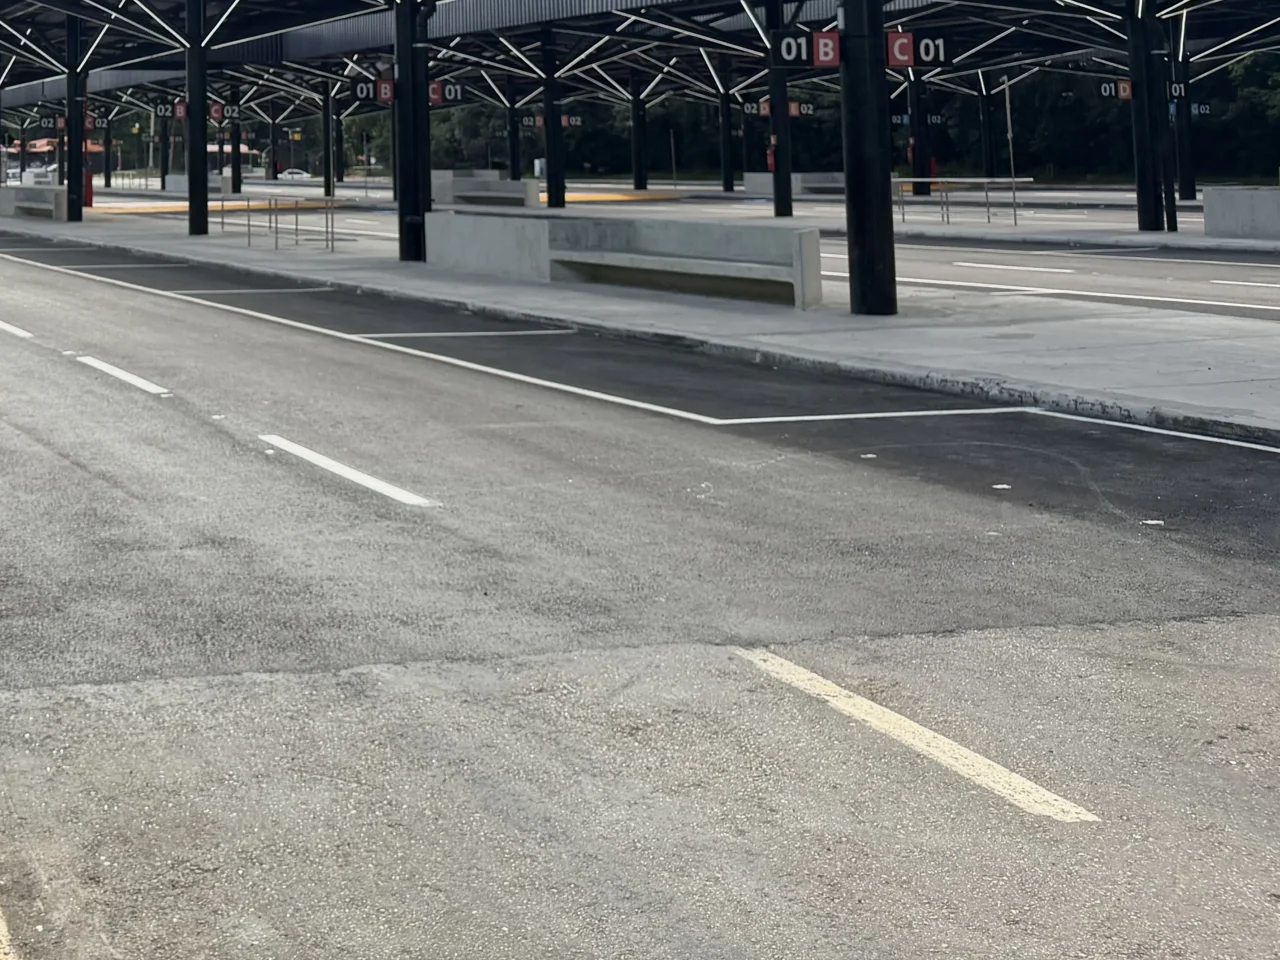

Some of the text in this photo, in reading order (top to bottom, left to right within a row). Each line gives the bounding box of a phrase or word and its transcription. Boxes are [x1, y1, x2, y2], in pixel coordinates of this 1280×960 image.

[780, 36, 834, 61] 01 B
[893, 38, 945, 62] C 01
[356, 82, 391, 99] 01 B
[428, 84, 461, 100] C 01
[1101, 83, 1115, 96] 01
[1171, 83, 1185, 97] 01
[156, 104, 173, 117] 02
[223, 106, 239, 117] 02
